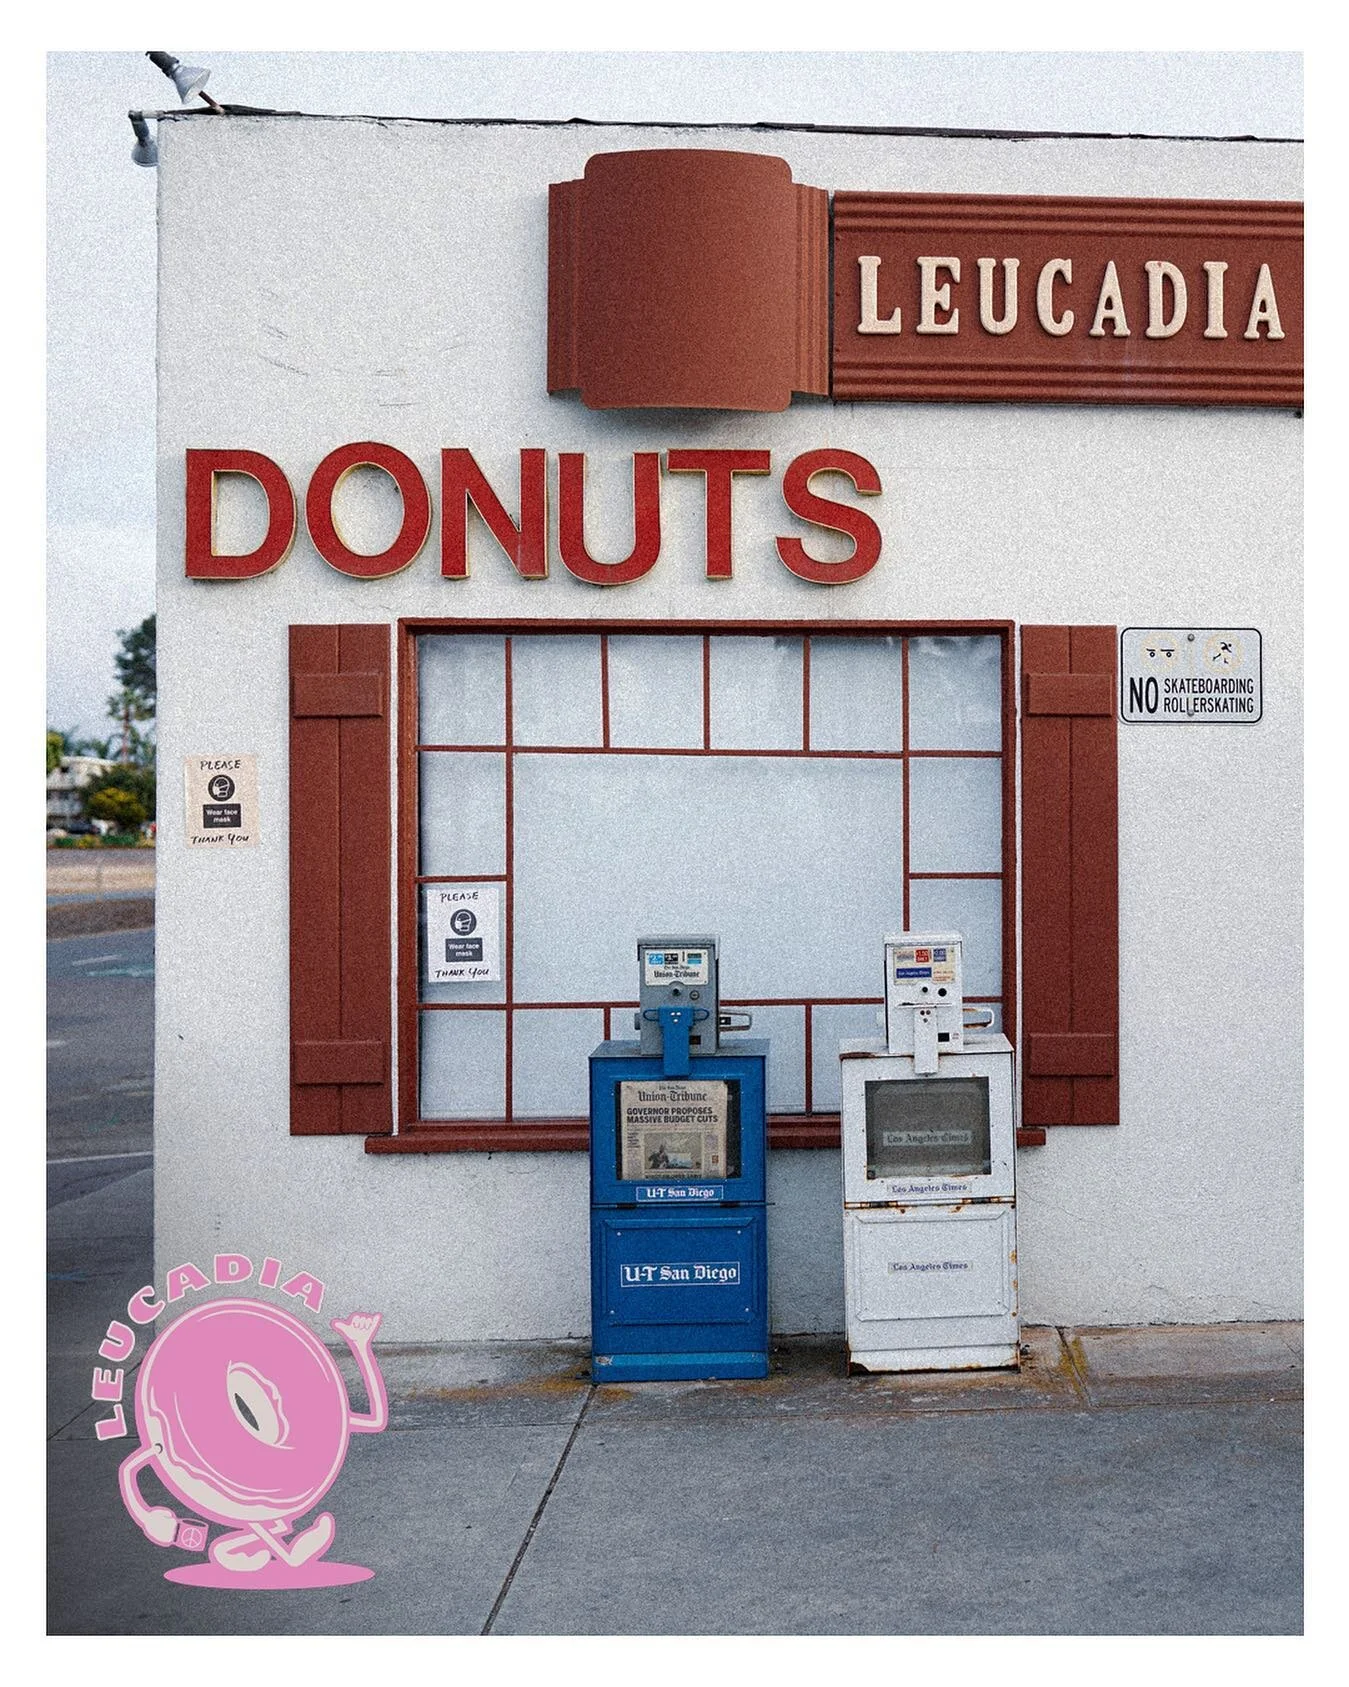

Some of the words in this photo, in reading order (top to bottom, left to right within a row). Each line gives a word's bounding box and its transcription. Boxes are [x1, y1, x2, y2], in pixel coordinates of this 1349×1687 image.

[857, 255, 1286, 341] LEUCADIA
[185, 441, 883, 586] DONUTS
[1163, 678, 1254, 694] SKATEBOARDING
[1129, 676, 1158, 714] NO
[200, 759, 241, 770] PLEASE
[224, 808, 238, 816] face
[190, 834, 225, 845] THANK
[440, 891, 479, 902] PLEASE
[435, 969, 465, 978] THANK
[638, 1090, 707, 1102] Union-Tribune
[626, 1107, 669, 1115] GOVERNOR
[671, 1106, 713, 1115] PROPOSES
[626, 1115, 662, 1124] MASSIVE
[663, 1115, 695, 1123] BUDGET
[696, 1114, 719, 1123] CUTS
[647, 1188, 666, 1198] U-T
[667, 1187, 686, 1198] San
[688, 1187, 715, 1199] Diego
[891, 1185, 906, 1193] Los
[908, 1185, 940, 1194] Angeles
[941, 1183, 968, 1192] Times
[893, 1263, 908, 1271] Los
[909, 1263, 941, 1272] Angeles
[942, 1261, 969, 1270] Times
[623, 1266, 658, 1282] U-T
[659, 1265, 690, 1281] San
[693, 1265, 738, 1283] Diego
